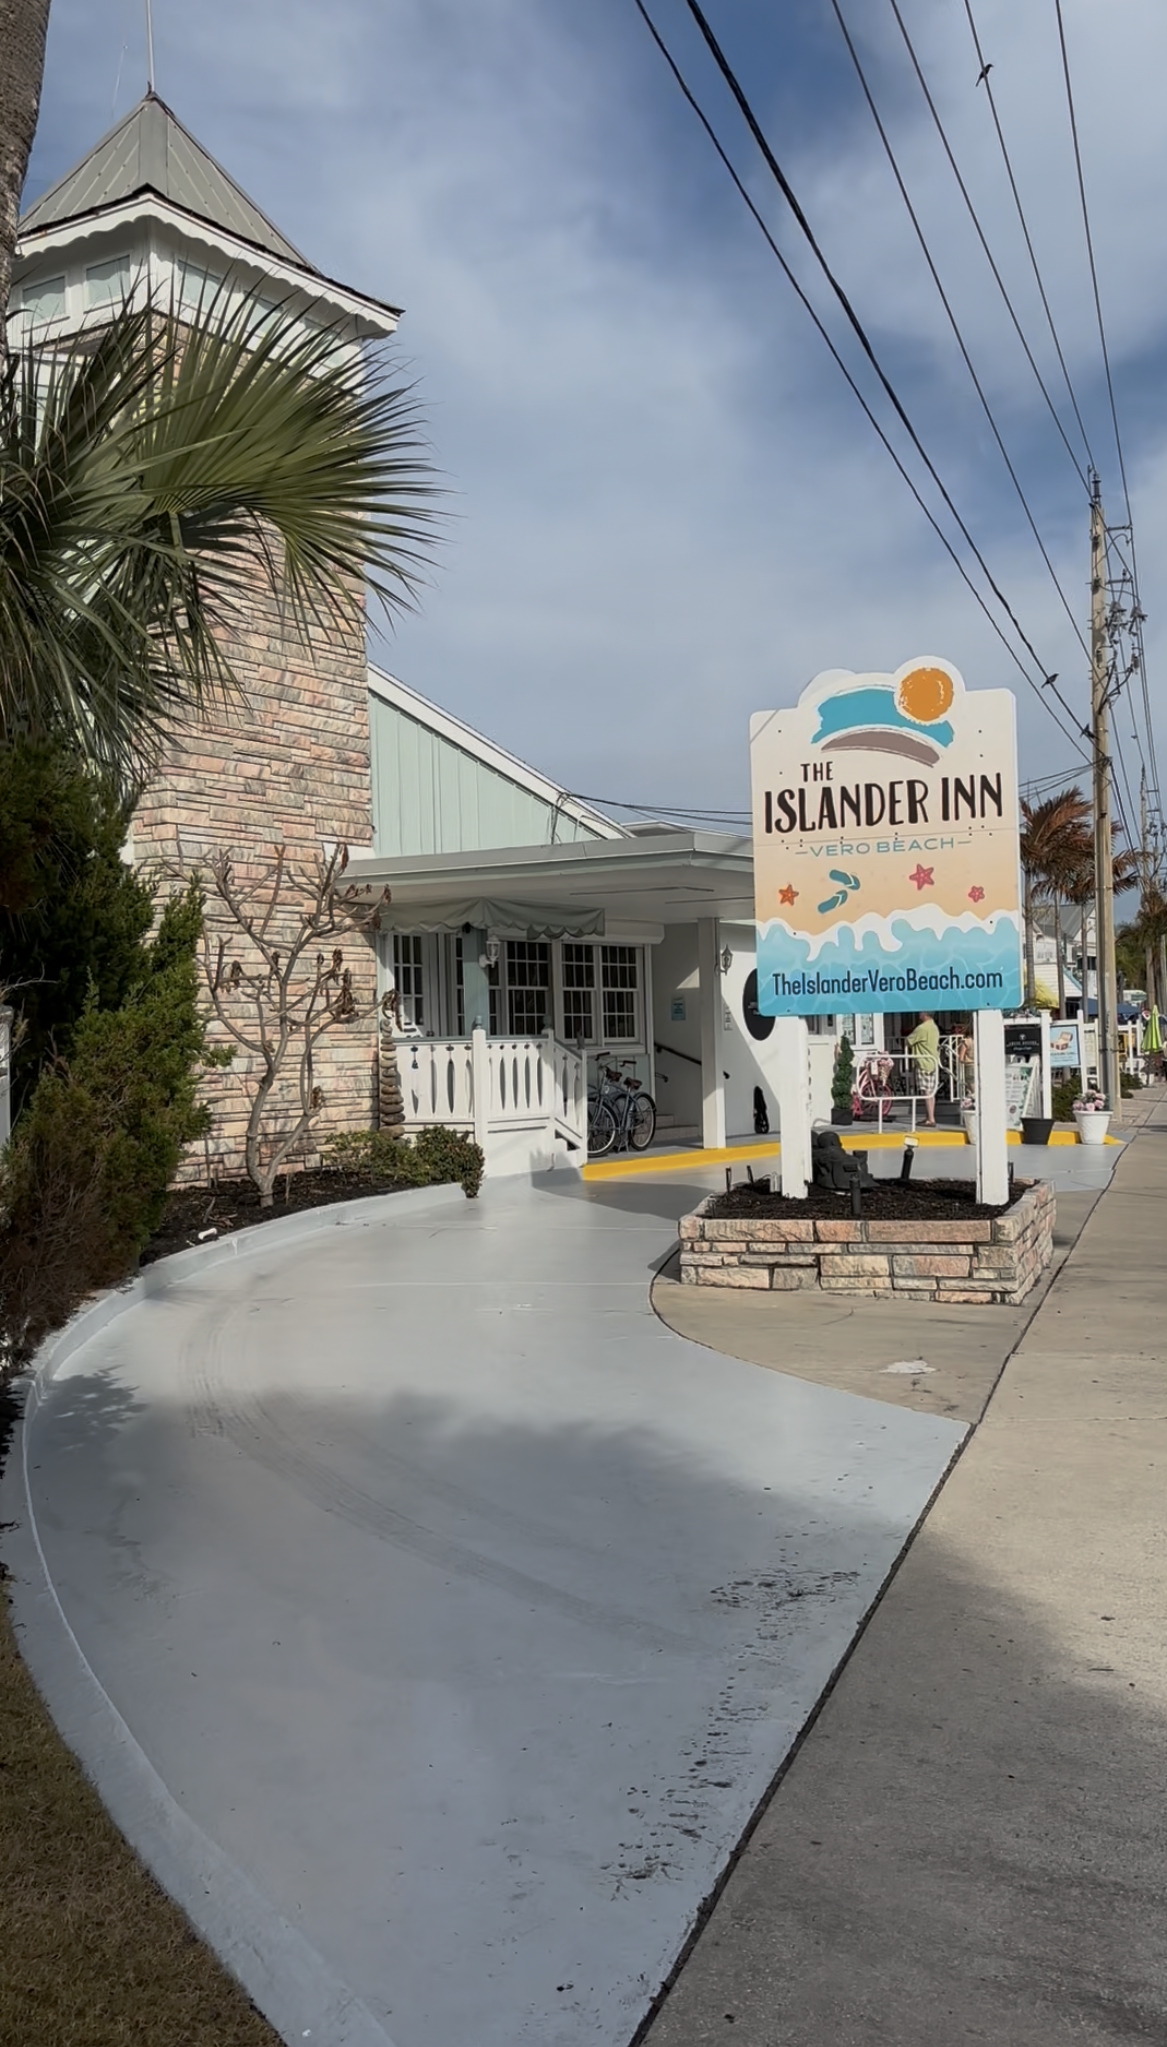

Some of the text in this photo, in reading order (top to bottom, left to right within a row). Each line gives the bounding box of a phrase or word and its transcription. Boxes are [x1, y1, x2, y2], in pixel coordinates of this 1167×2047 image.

[800, 761, 834, 782] THE
[764, 772, 1004, 834] ISLANDER INN
[809, 837, 955, 857] VERO BEACH
[772, 967, 1003, 997] TheIslanderVeroBeach.com
